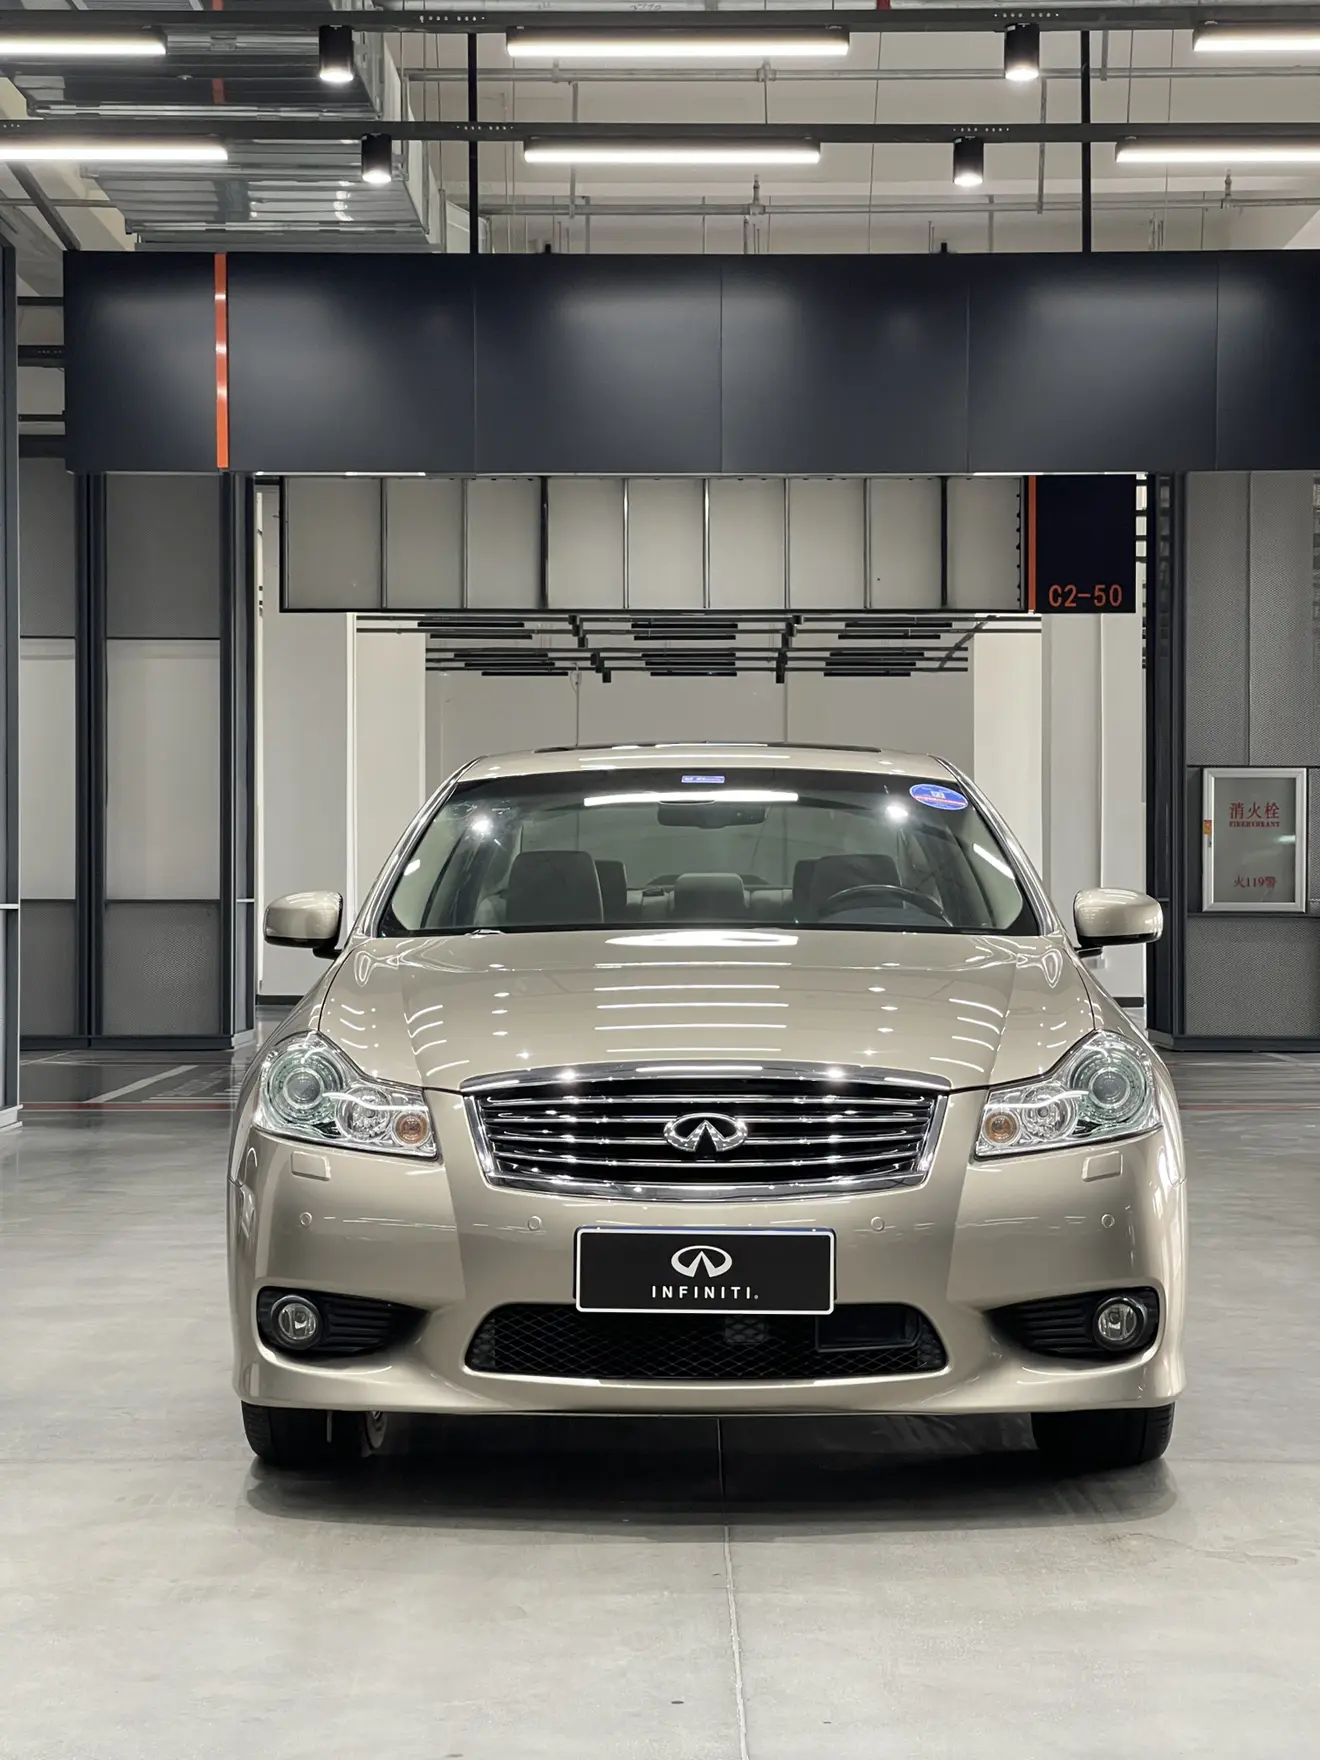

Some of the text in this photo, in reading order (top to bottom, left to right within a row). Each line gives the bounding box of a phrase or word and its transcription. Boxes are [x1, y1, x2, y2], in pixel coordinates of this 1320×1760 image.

[1048, 584, 1123, 607] C2-50
[1229, 801, 1280, 819] 消火栓
[652, 1285, 751, 1300] INFINITI
